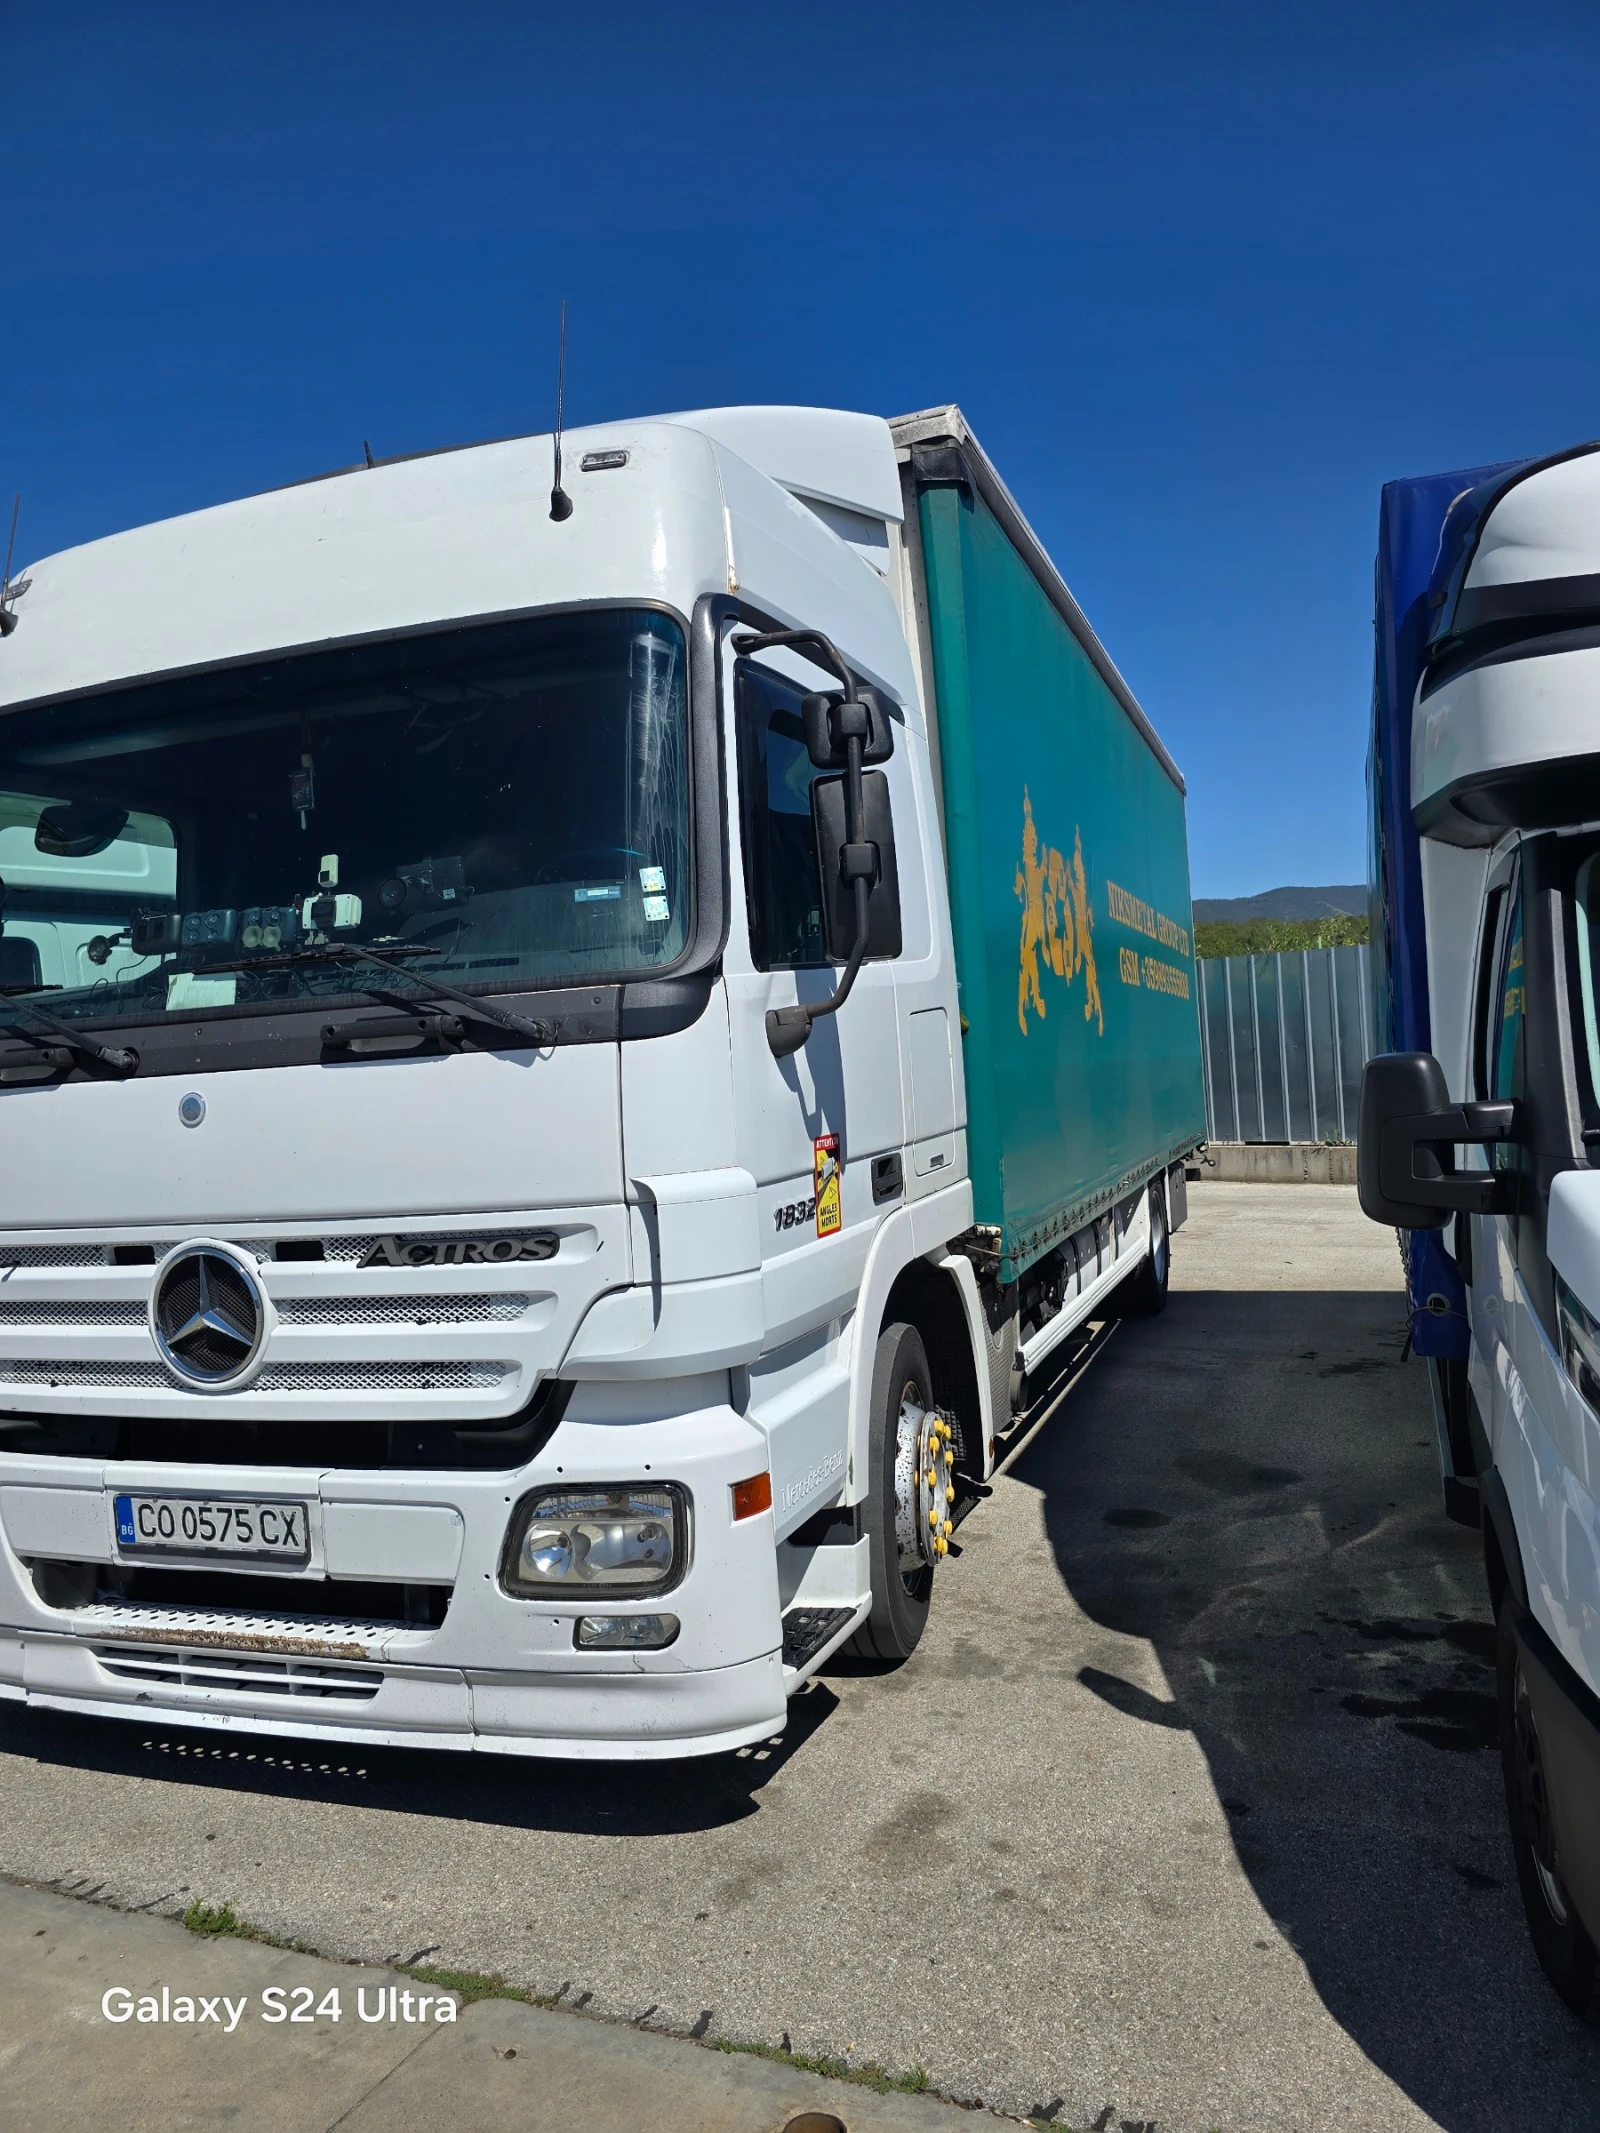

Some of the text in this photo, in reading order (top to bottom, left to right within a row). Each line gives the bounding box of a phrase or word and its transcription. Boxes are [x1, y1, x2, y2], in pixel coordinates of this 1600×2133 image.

[1106, 879, 1157, 940] NIKSMETAL
[1157, 911, 1179, 951] GROUP
[1119, 946, 1140, 987] GSM
[774, 1197, 816, 1232] 1832
[820, 1203, 838, 1217] ANGLES
[821, 1216, 838, 1229] MORTS
[781, 1449, 843, 1512] Mercedes-Benz
[121, 1524, 134, 1536] BG
[138, 1503, 300, 1547] CO 0575 CX
